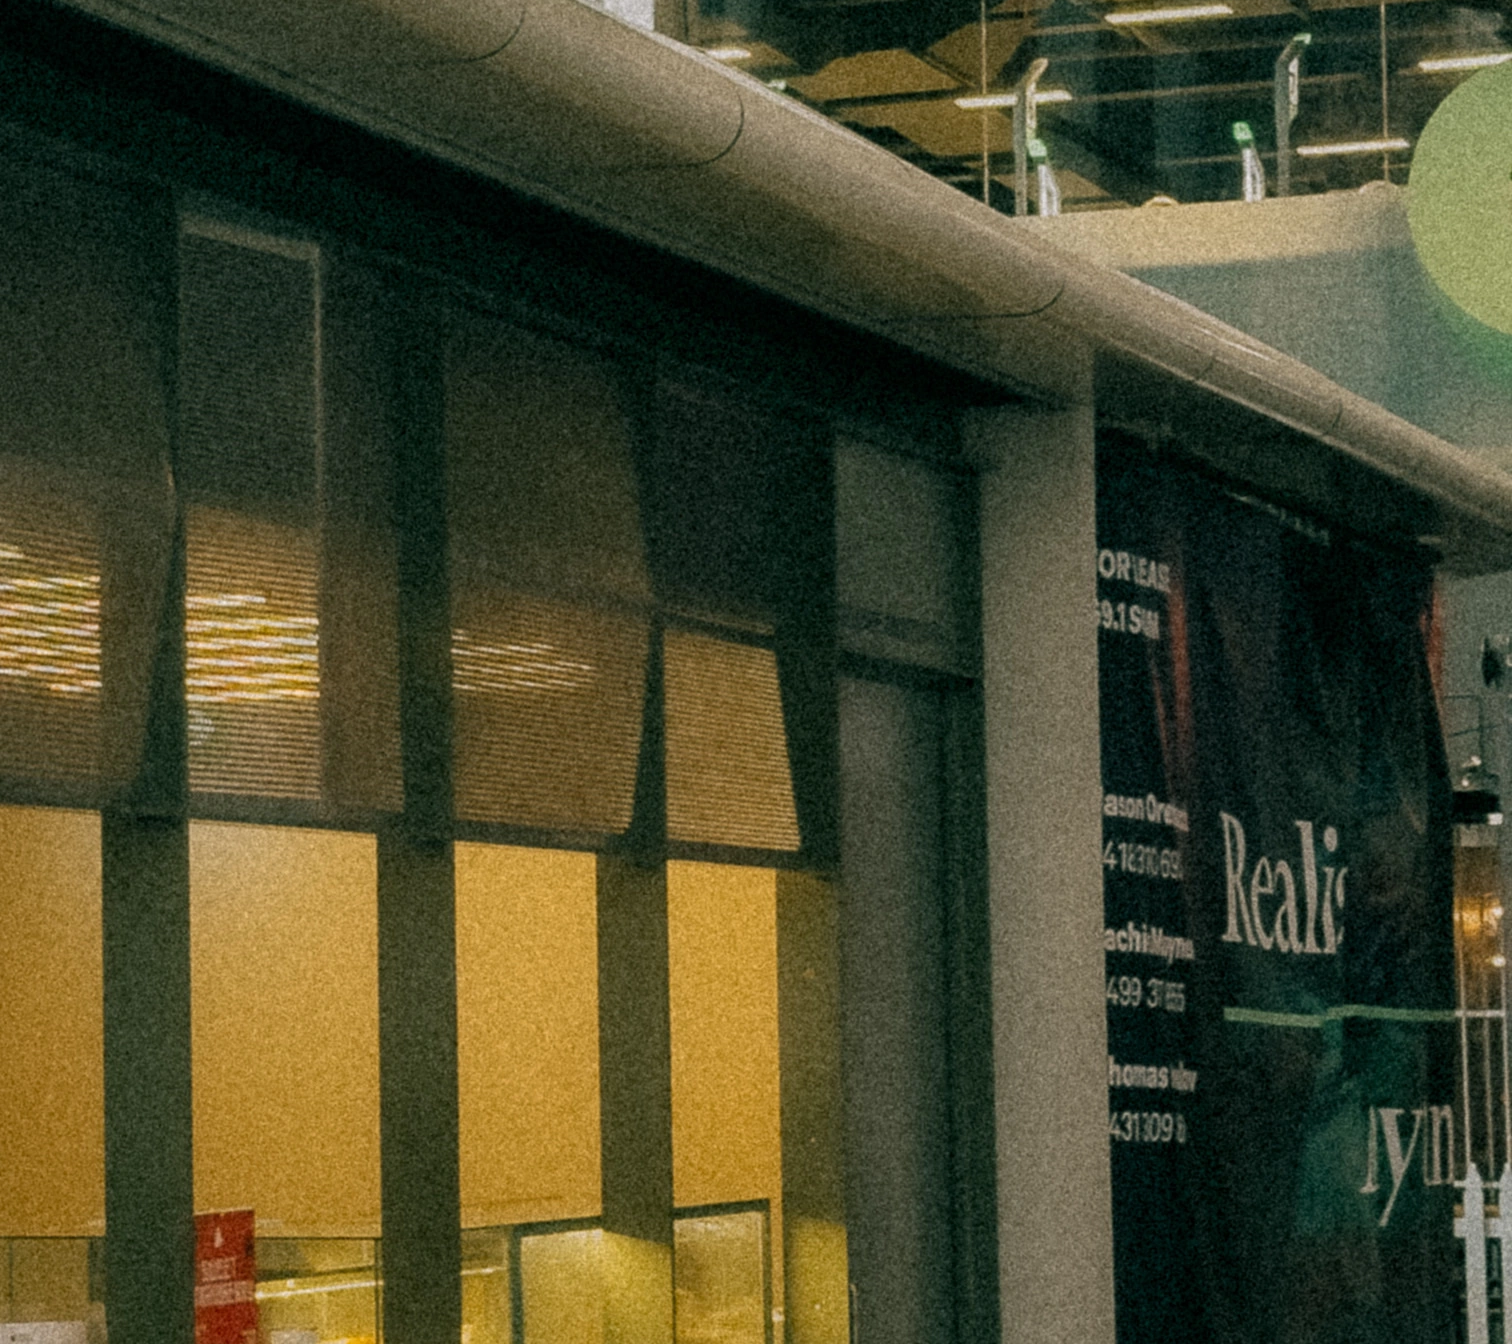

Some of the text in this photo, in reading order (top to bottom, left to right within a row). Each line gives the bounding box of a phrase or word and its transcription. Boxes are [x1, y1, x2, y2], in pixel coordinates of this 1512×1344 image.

[1098, 549, 1131, 581] OR
[1099, 599, 1127, 633] 9.1
[1102, 794, 1144, 821] ason
[1108, 1054, 1169, 1089] homas
